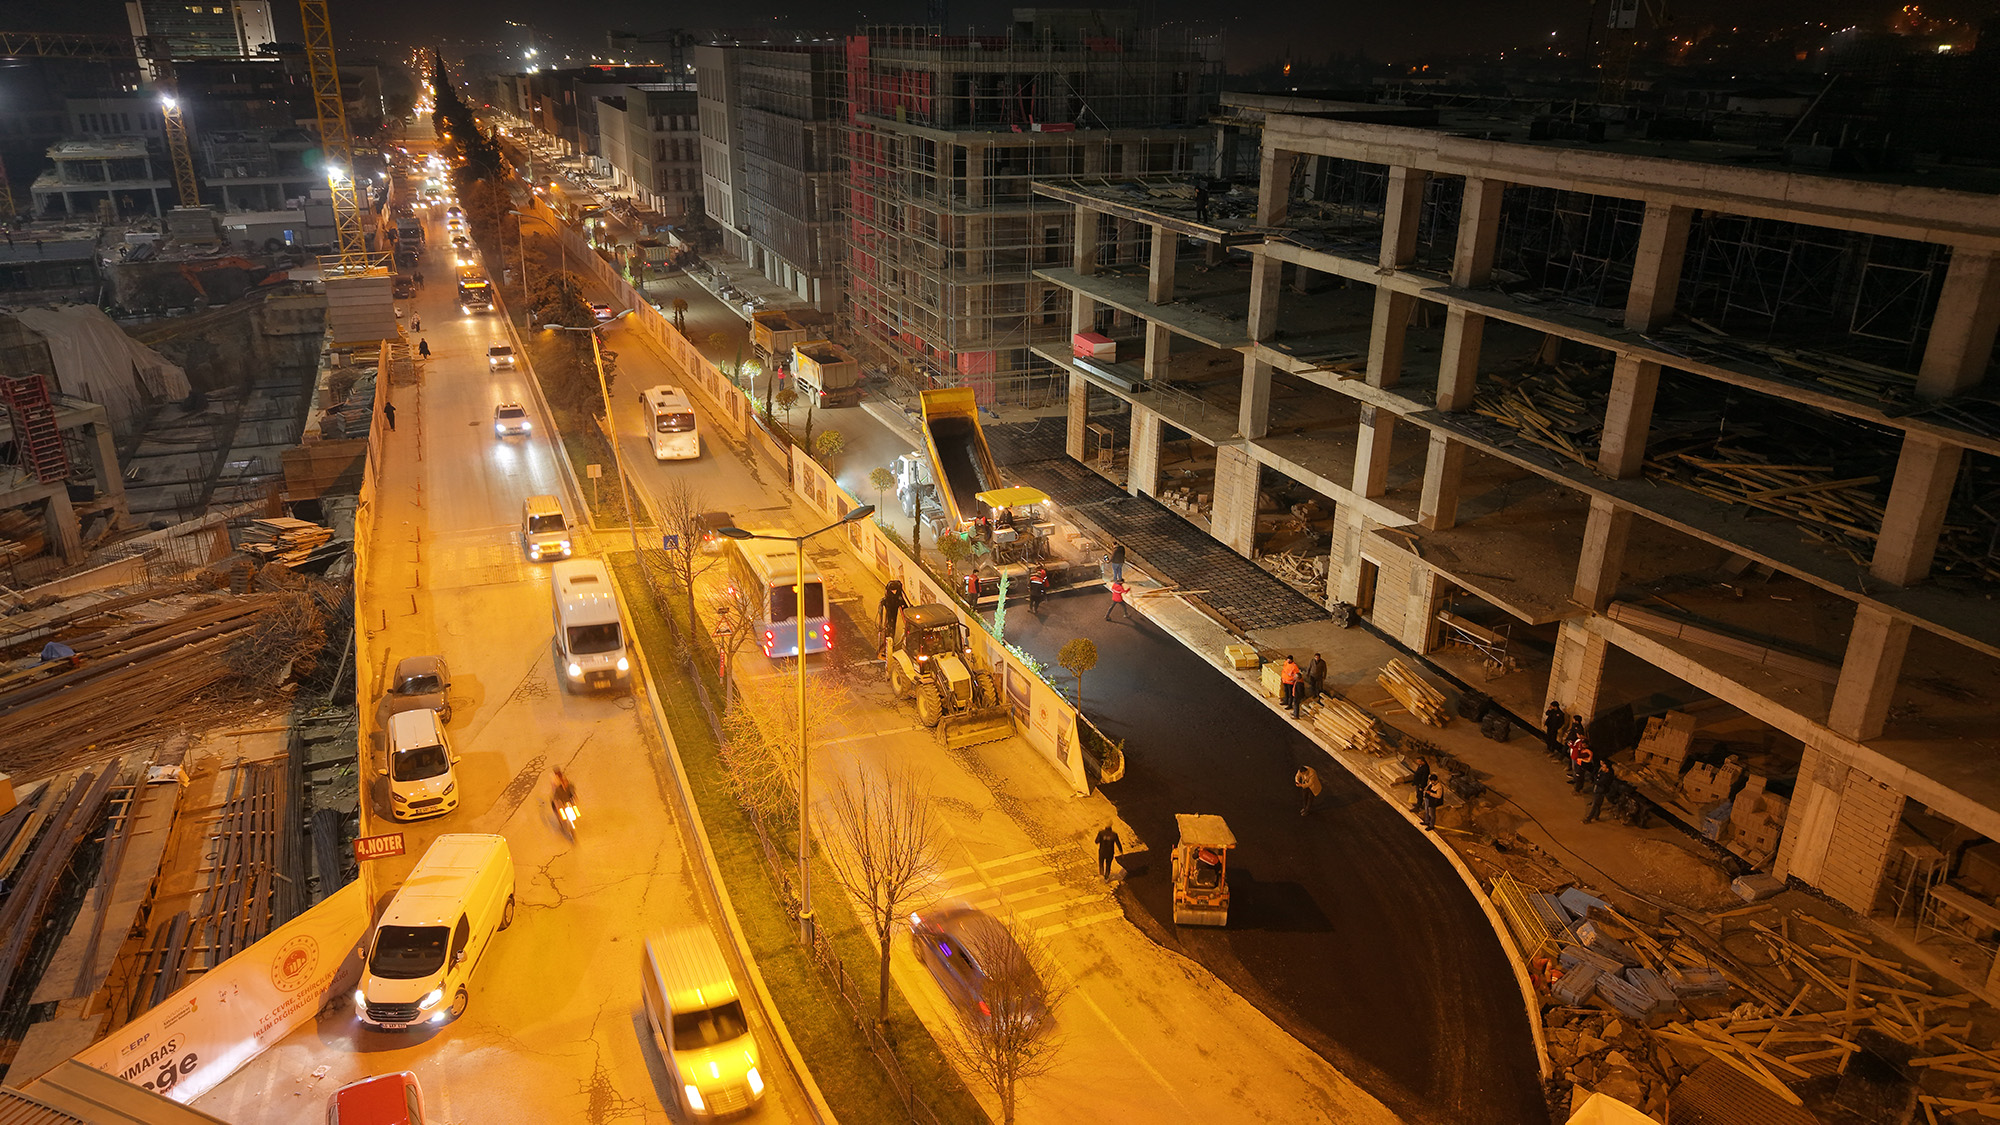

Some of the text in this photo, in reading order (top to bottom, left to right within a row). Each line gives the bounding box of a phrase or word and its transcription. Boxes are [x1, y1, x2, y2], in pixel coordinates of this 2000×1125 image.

[358, 835, 403, 855] 4.NOTER
[258, 1013, 272, 1024] T.C.
[253, 1022, 273, 1039] İKLİM
